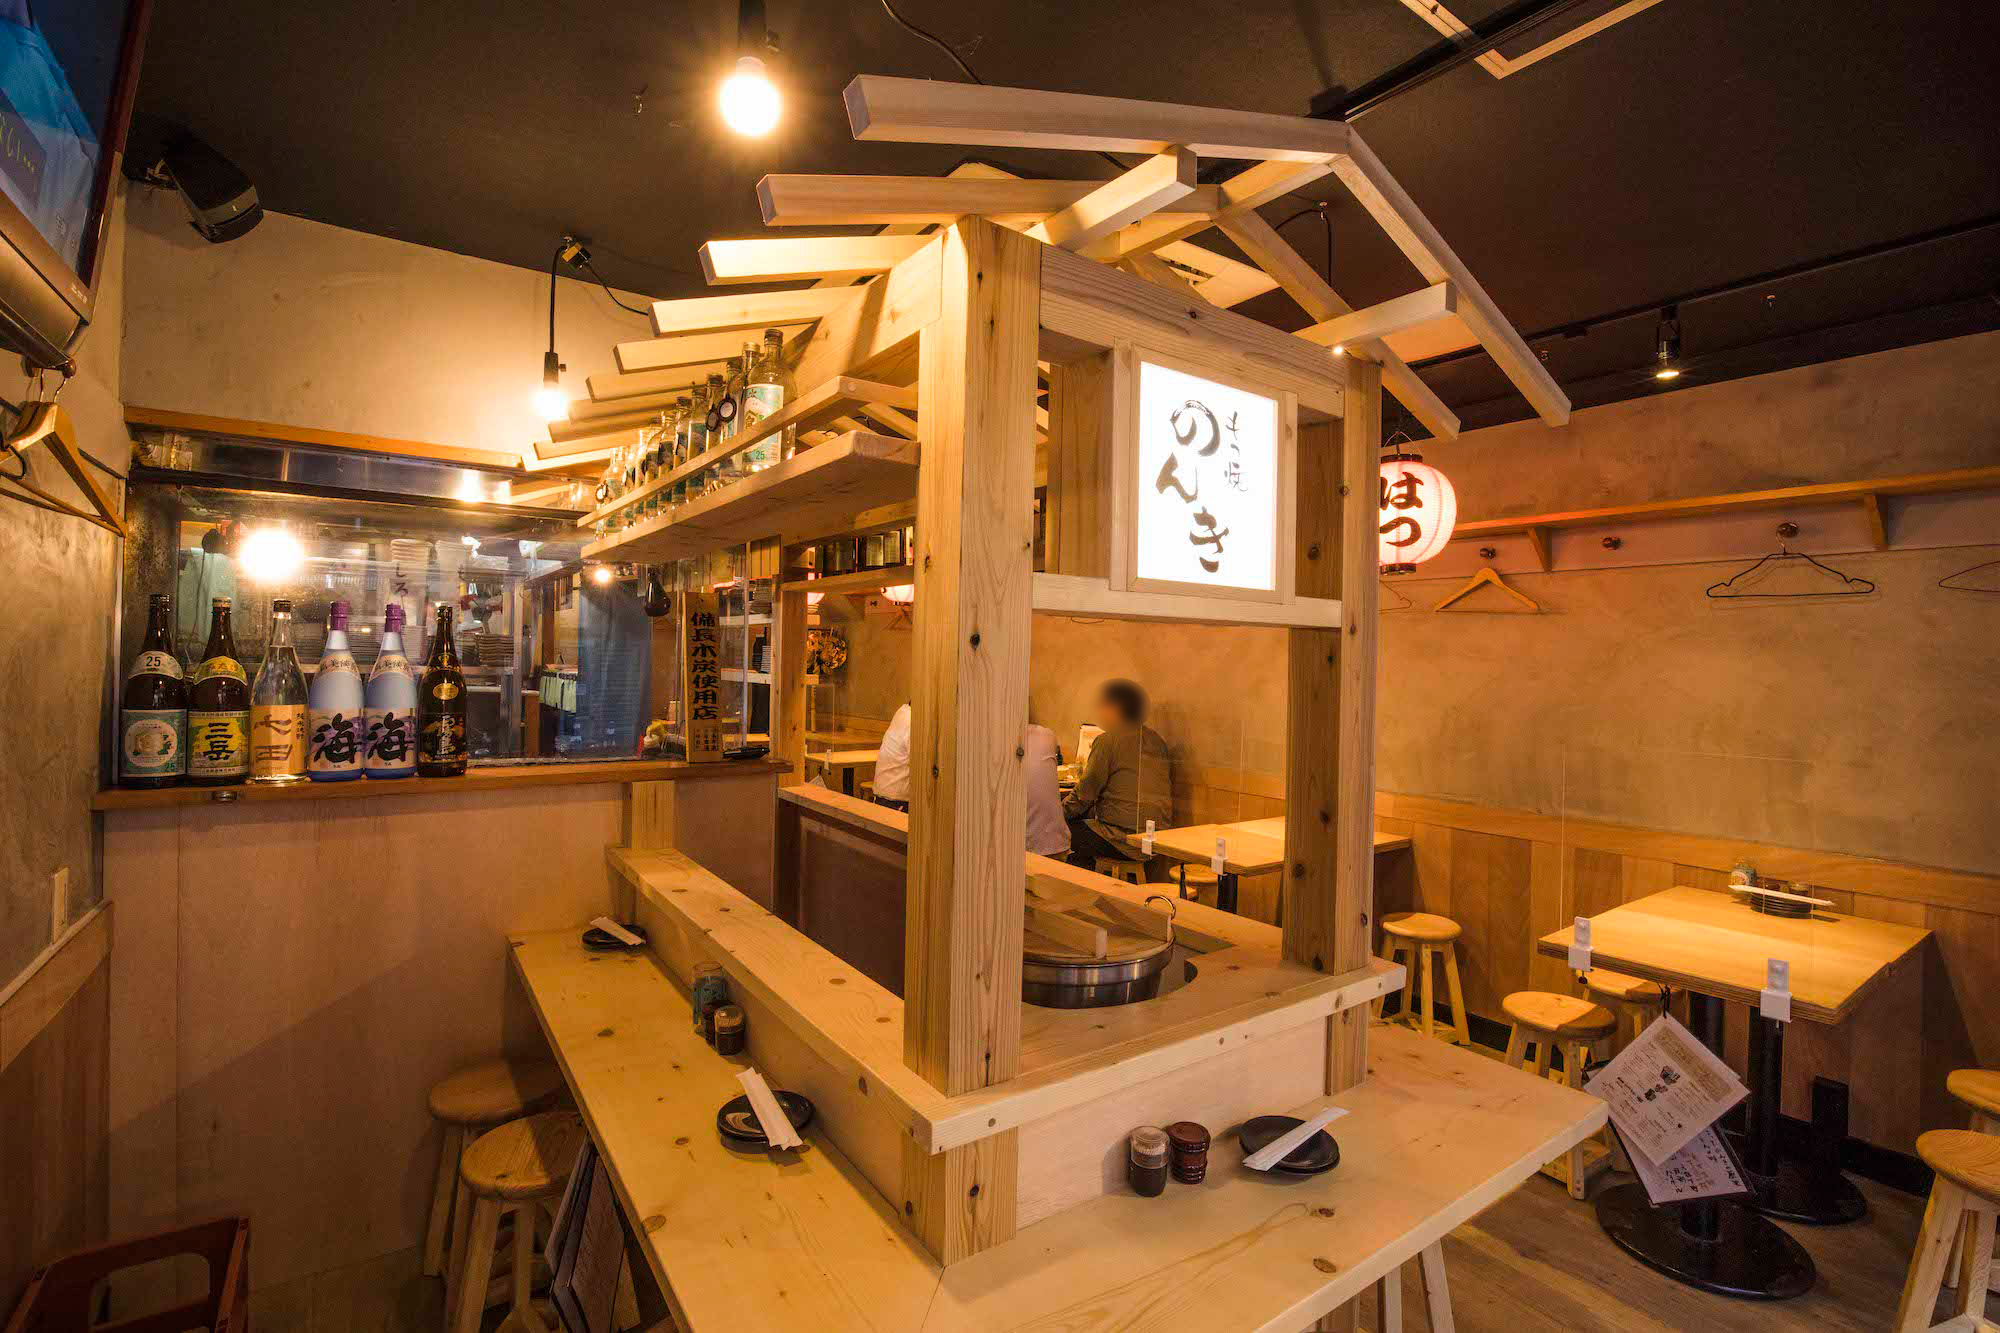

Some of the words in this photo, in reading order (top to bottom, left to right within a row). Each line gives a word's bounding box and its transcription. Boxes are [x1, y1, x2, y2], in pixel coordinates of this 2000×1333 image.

[1155, 400, 1230, 573] のんき
[1380, 471, 1424, 547] はつ
[146, 656, 161, 667] 25
[203, 722, 236, 761] 三岳
[311, 712, 363, 765] 海
[367, 712, 416, 763] 海
